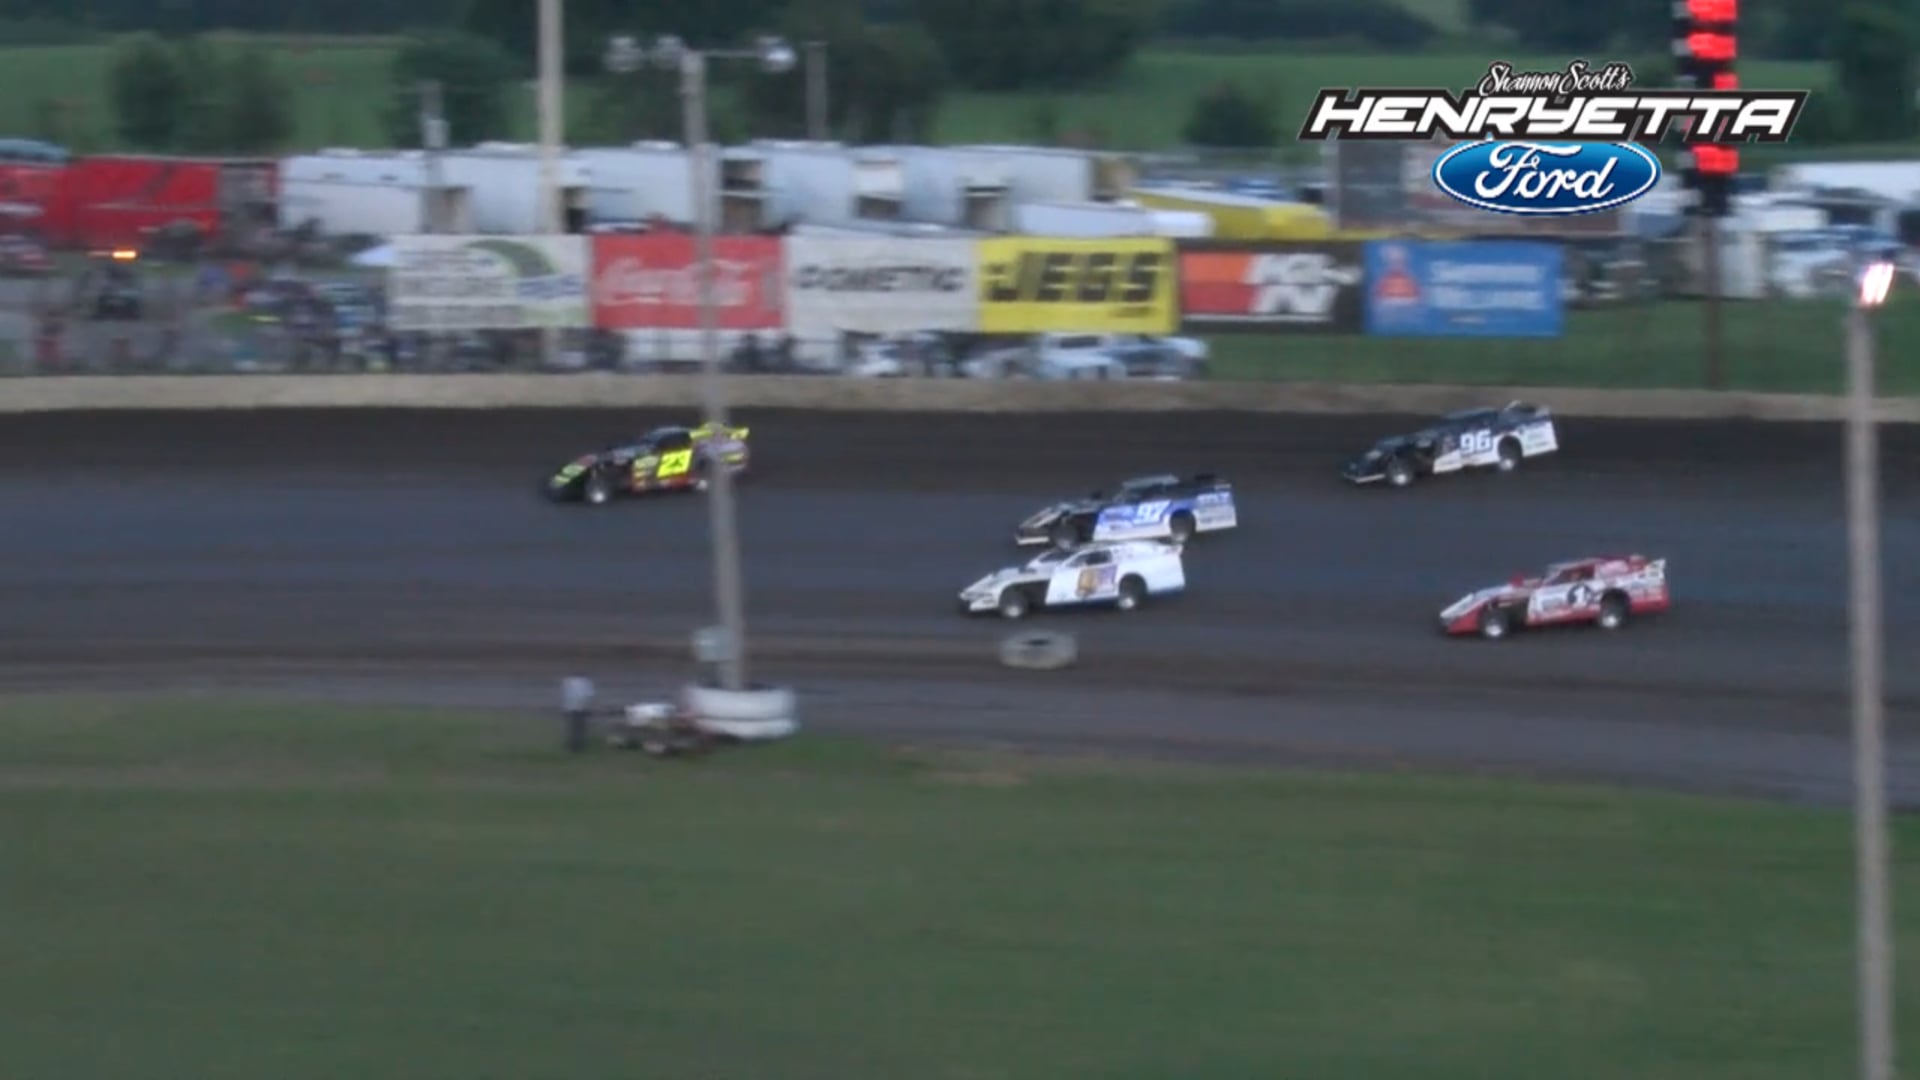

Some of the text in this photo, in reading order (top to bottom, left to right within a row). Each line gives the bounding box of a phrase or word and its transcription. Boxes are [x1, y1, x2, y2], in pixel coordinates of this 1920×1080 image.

[988, 252, 1160, 302] JEGS
[1460, 429, 1492, 453] 96
[1134, 500, 1170, 524] 97
